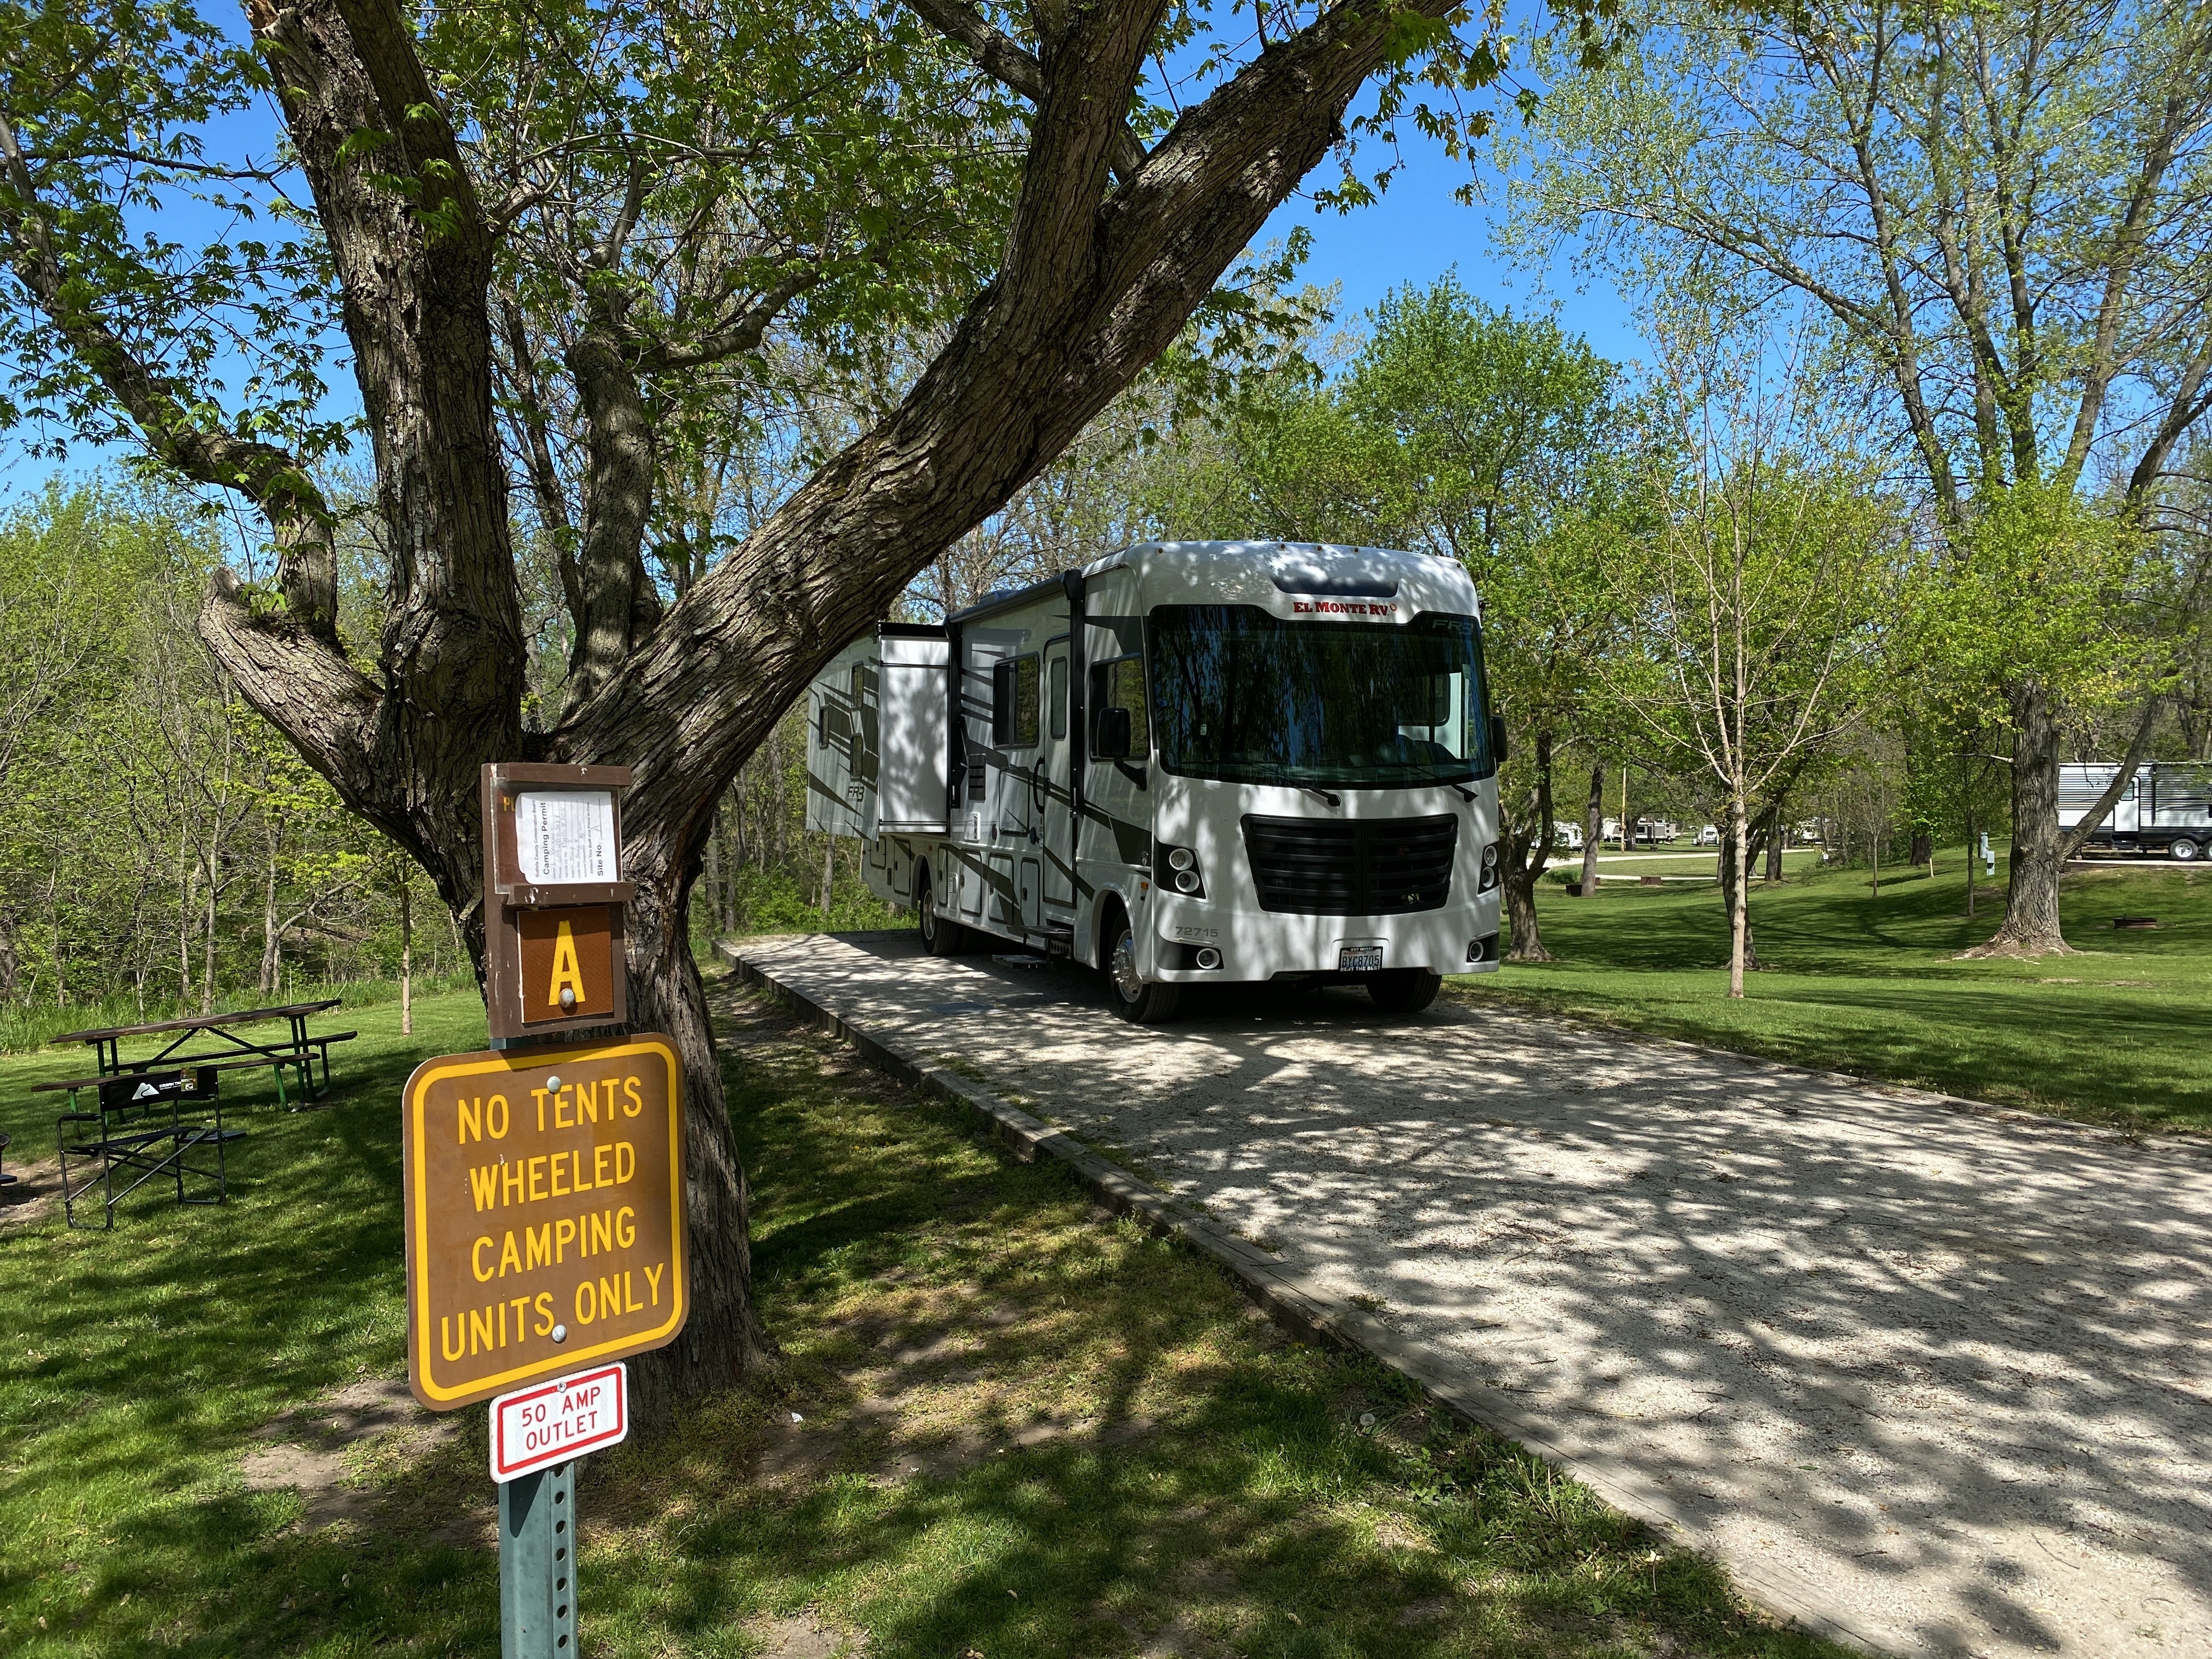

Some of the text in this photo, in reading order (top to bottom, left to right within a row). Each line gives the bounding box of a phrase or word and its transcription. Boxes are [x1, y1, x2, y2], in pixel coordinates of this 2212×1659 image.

[1293, 602, 1388, 616] EL MONTE RV
[848, 786, 865, 802] FR3
[1175, 927, 1218, 937] 72715
[549, 920, 585, 1006] A
[1342, 955, 1380, 967] BYC8705
[458, 1075, 642, 1144] NO TENTS
[469, 1142, 636, 1212] WHEELED
[472, 1206, 636, 1282] CAMPING
[441, 1263, 664, 1362] UNITS ONLY
[522, 1386, 601, 1427] 50 AMP
[526, 1411, 597, 1451] OUTLET
